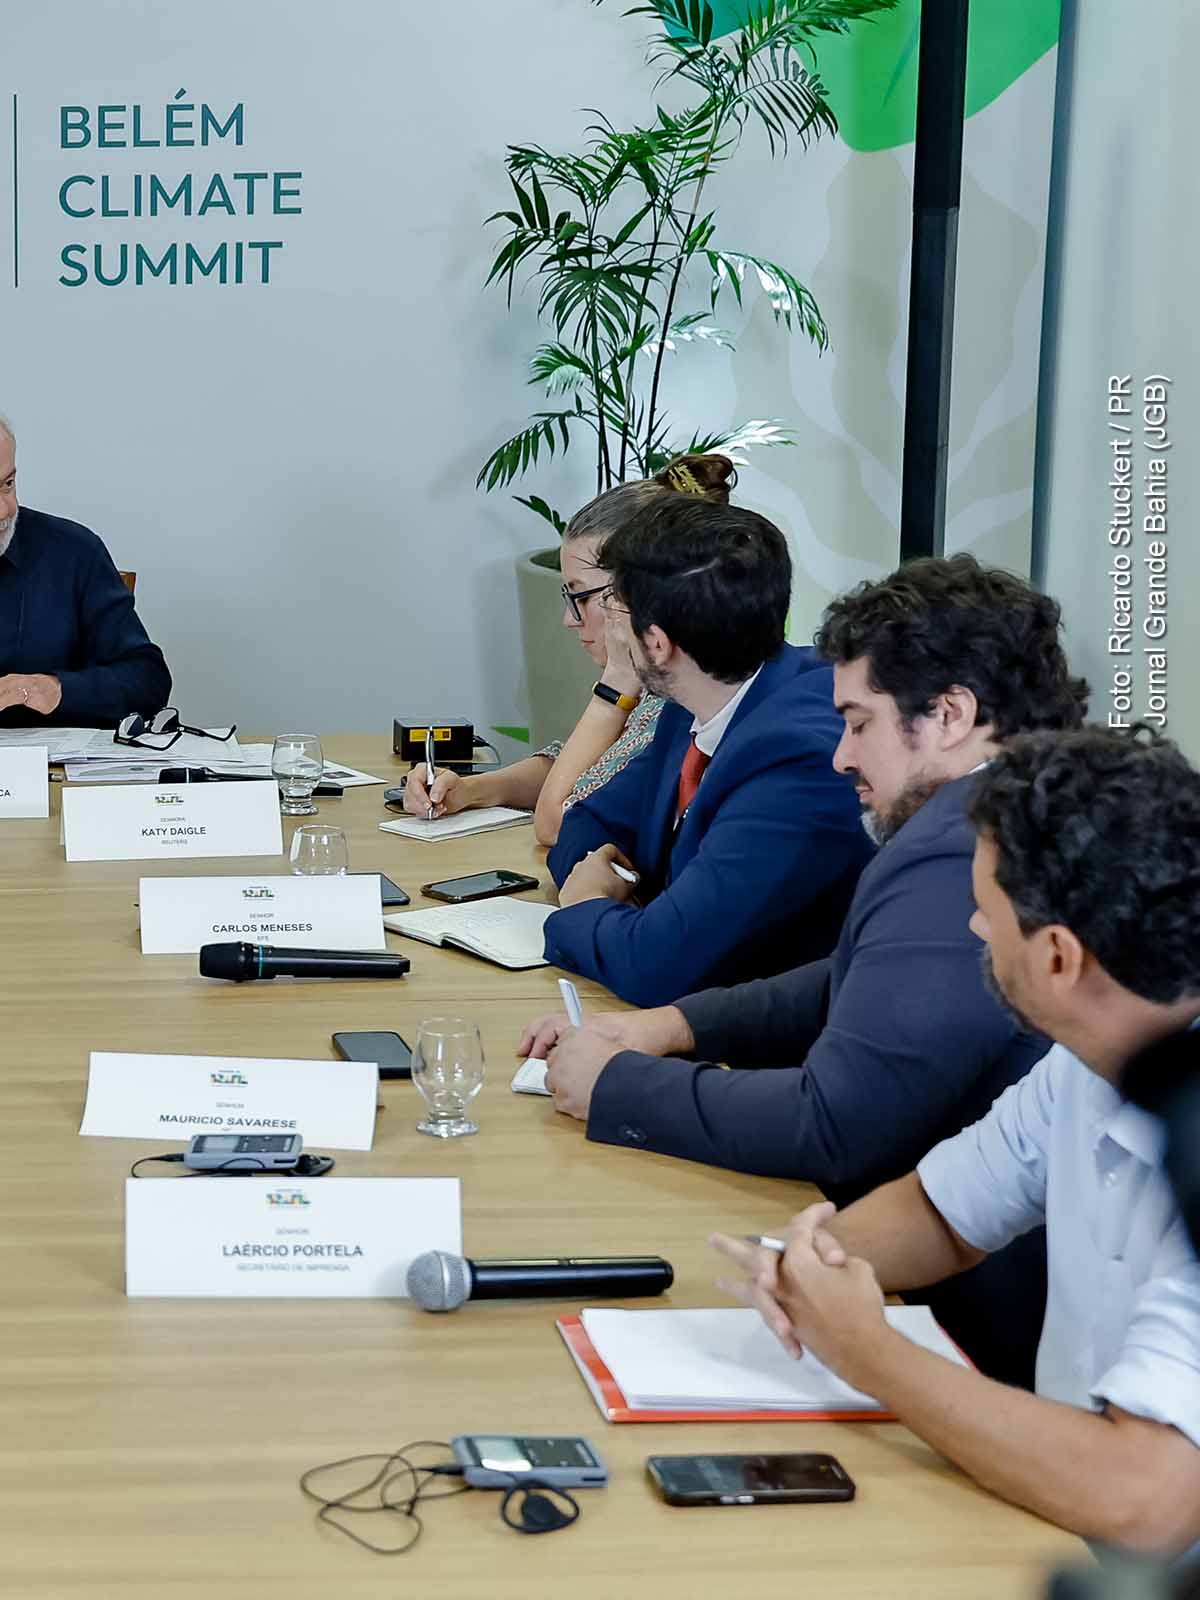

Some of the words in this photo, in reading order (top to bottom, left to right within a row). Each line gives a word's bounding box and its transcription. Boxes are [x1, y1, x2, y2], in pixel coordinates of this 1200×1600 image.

[59, 87, 244, 149] BELÉM
[58, 171, 303, 218] CLIMATE
[58, 241, 283, 288] SUMMIT
[141, 827, 168, 837] KATY
[169, 826, 207, 836] DAIGLE
[212, 924, 258, 933] CARLOS
[260, 923, 313, 932] MENESES
[159, 1114, 224, 1126] MAURICIO
[226, 1117, 297, 1129] SAVARESE
[221, 1243, 289, 1257] LAÉRCIO
[292, 1244, 364, 1257] PORTELA
